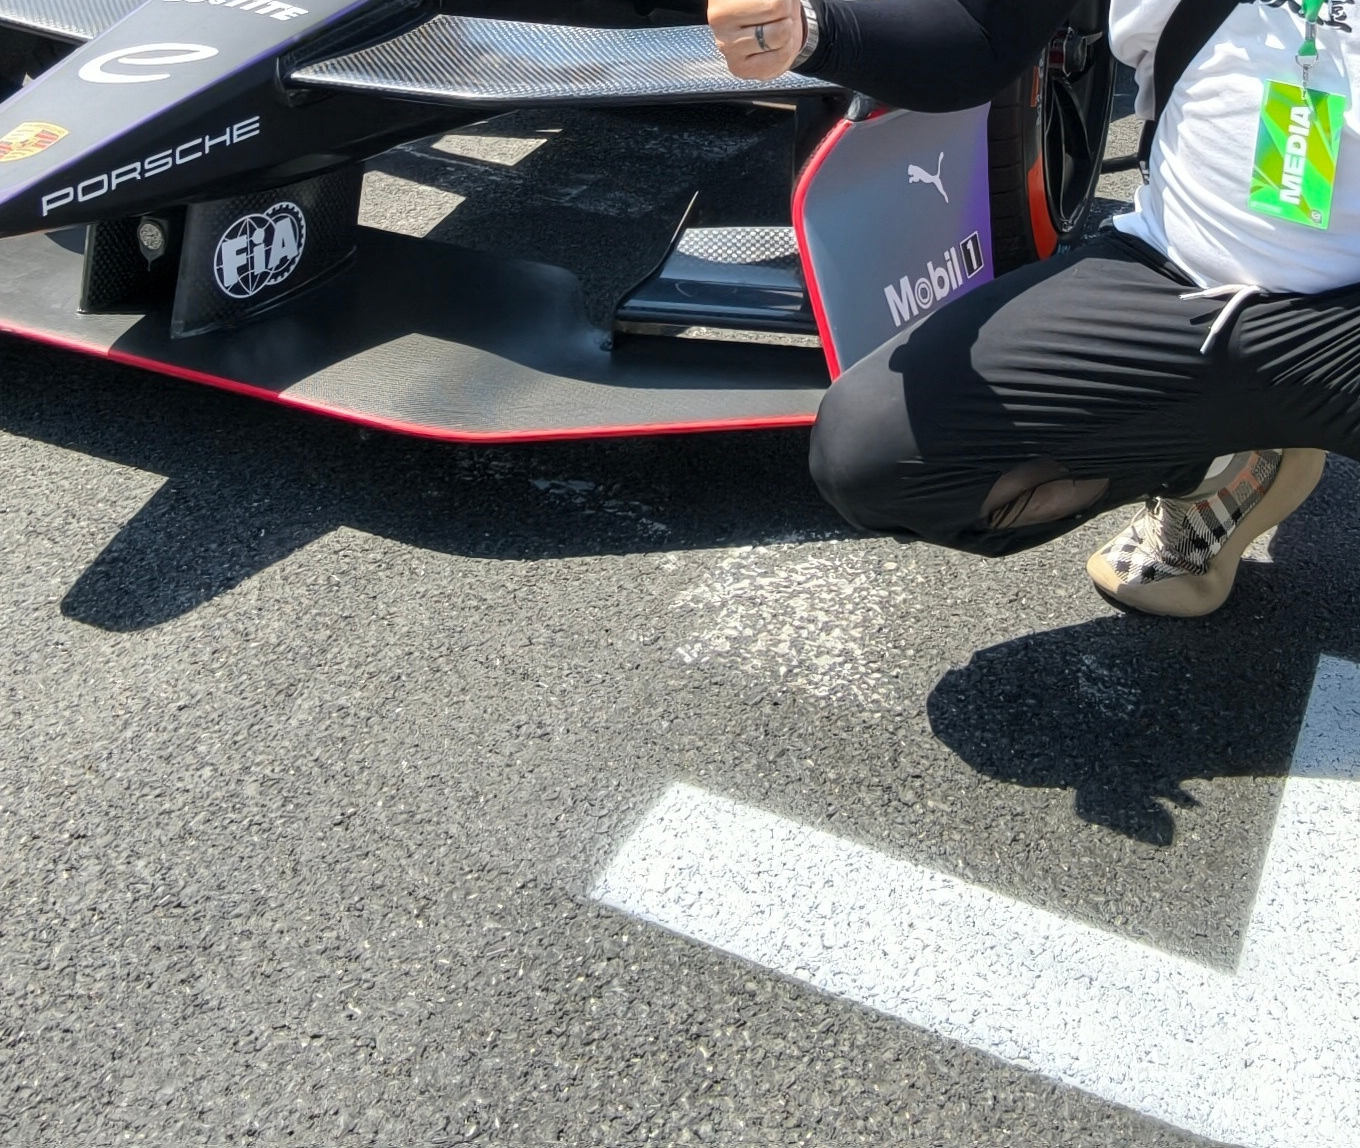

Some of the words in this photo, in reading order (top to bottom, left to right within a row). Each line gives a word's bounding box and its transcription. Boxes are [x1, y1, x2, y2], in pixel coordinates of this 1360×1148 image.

[41, 115, 261, 217] PORSCHE
[1279, 106, 1312, 206] MEDIA
[883, 246, 964, 328] Mobil
